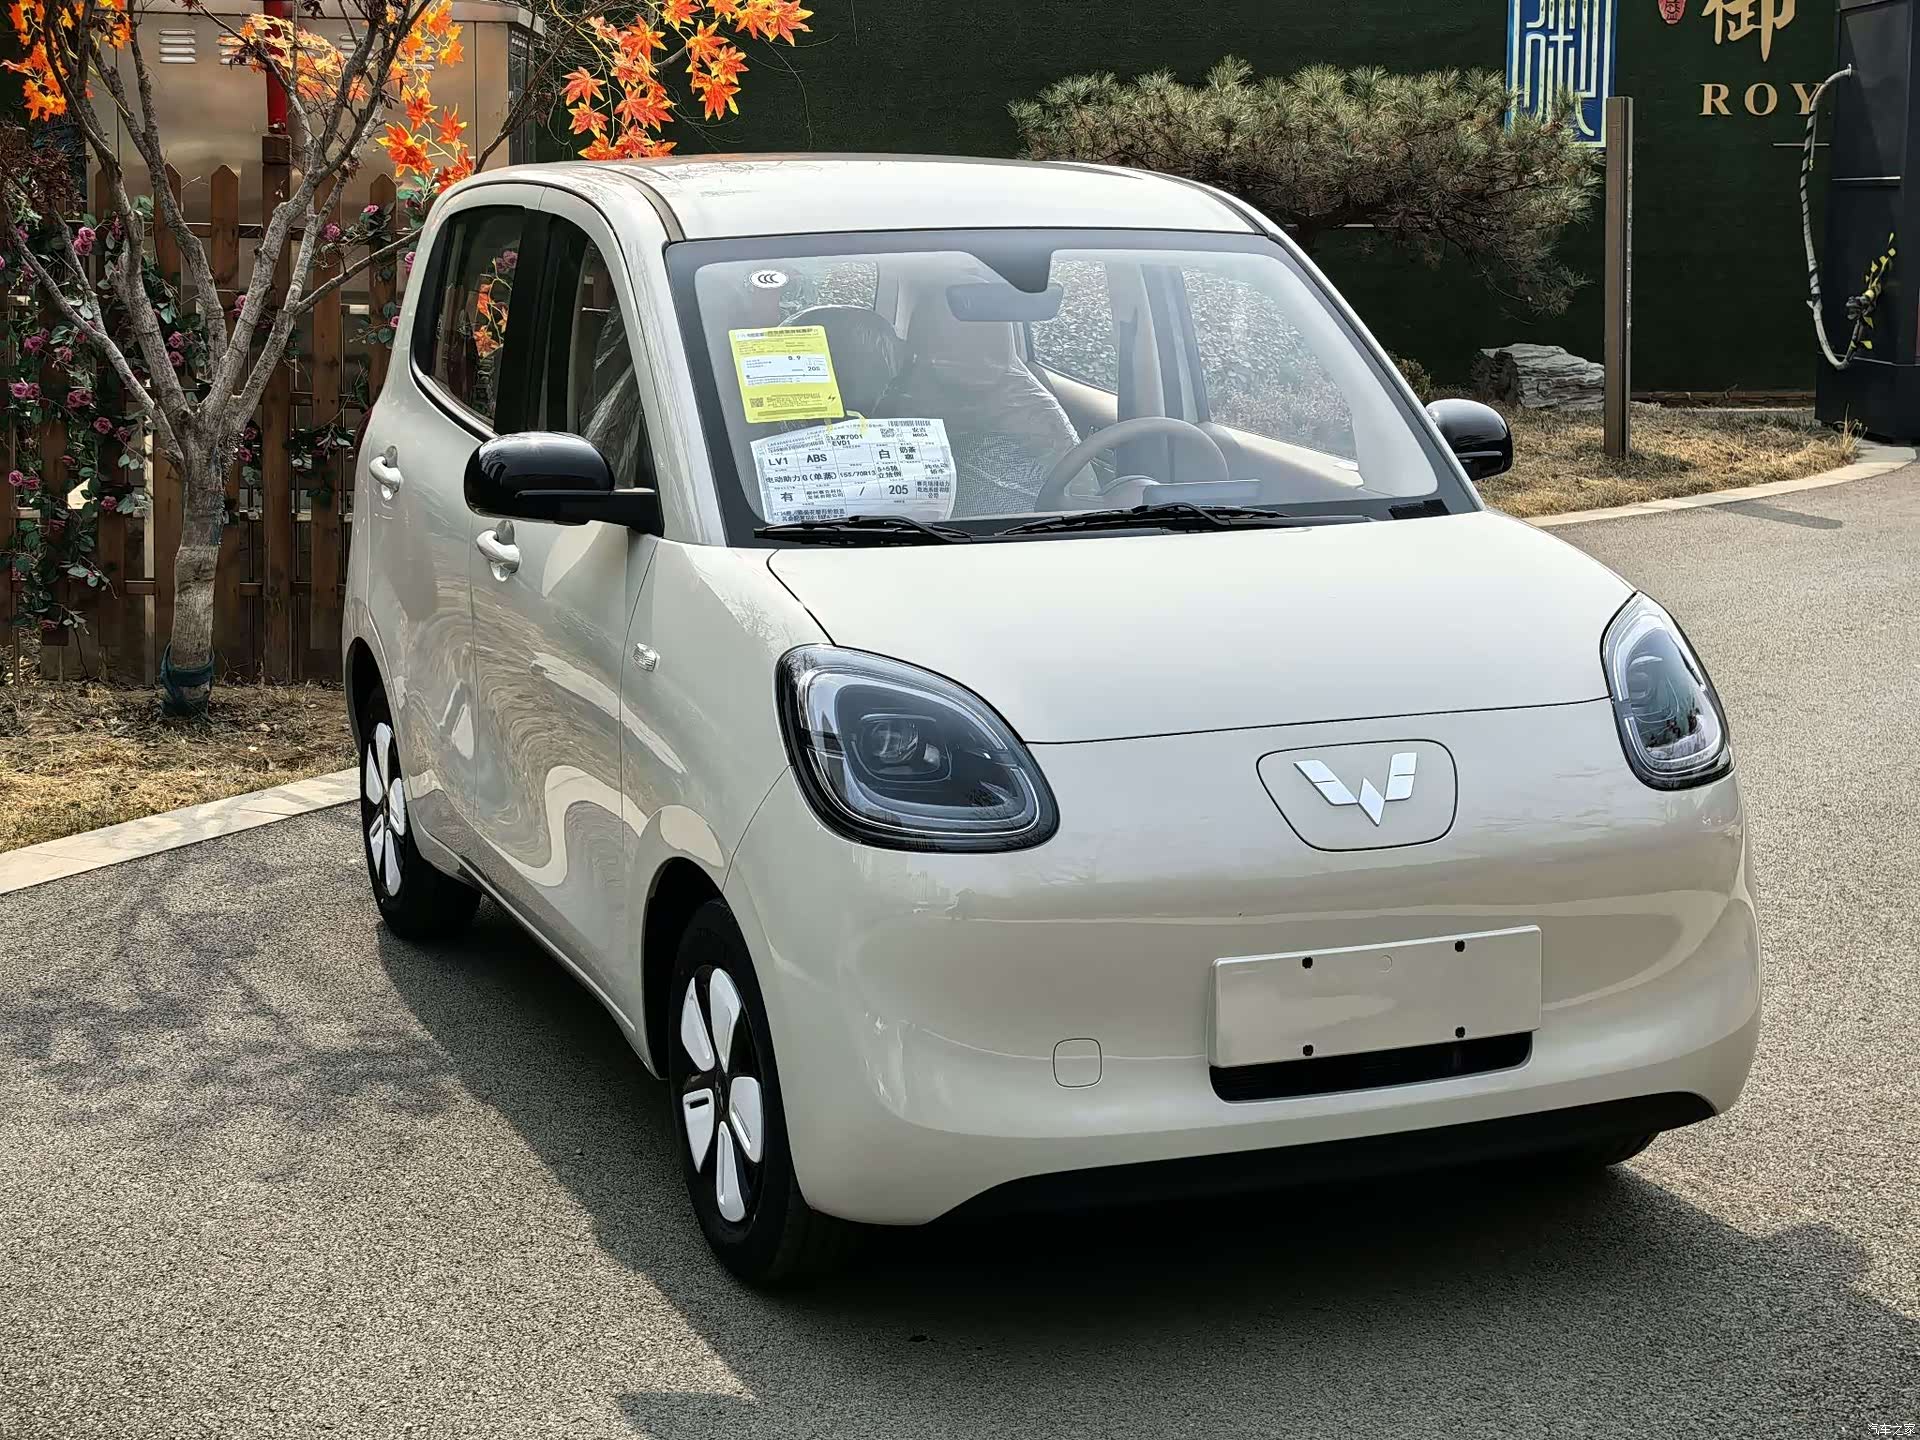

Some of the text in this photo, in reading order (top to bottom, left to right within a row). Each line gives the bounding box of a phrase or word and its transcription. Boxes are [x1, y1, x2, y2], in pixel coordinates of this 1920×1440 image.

[1699, 81, 1823, 117] ROY
[757, 273, 779, 284] CCC
[878, 449, 891, 460] 白
[899, 446, 917, 454] 奶茶
[768, 457, 789, 466] LV1
[806, 454, 828, 464] ABS
[765, 474, 801, 483] 电动助力
[888, 484, 909, 495] 205
[780, 491, 794, 503] 有
